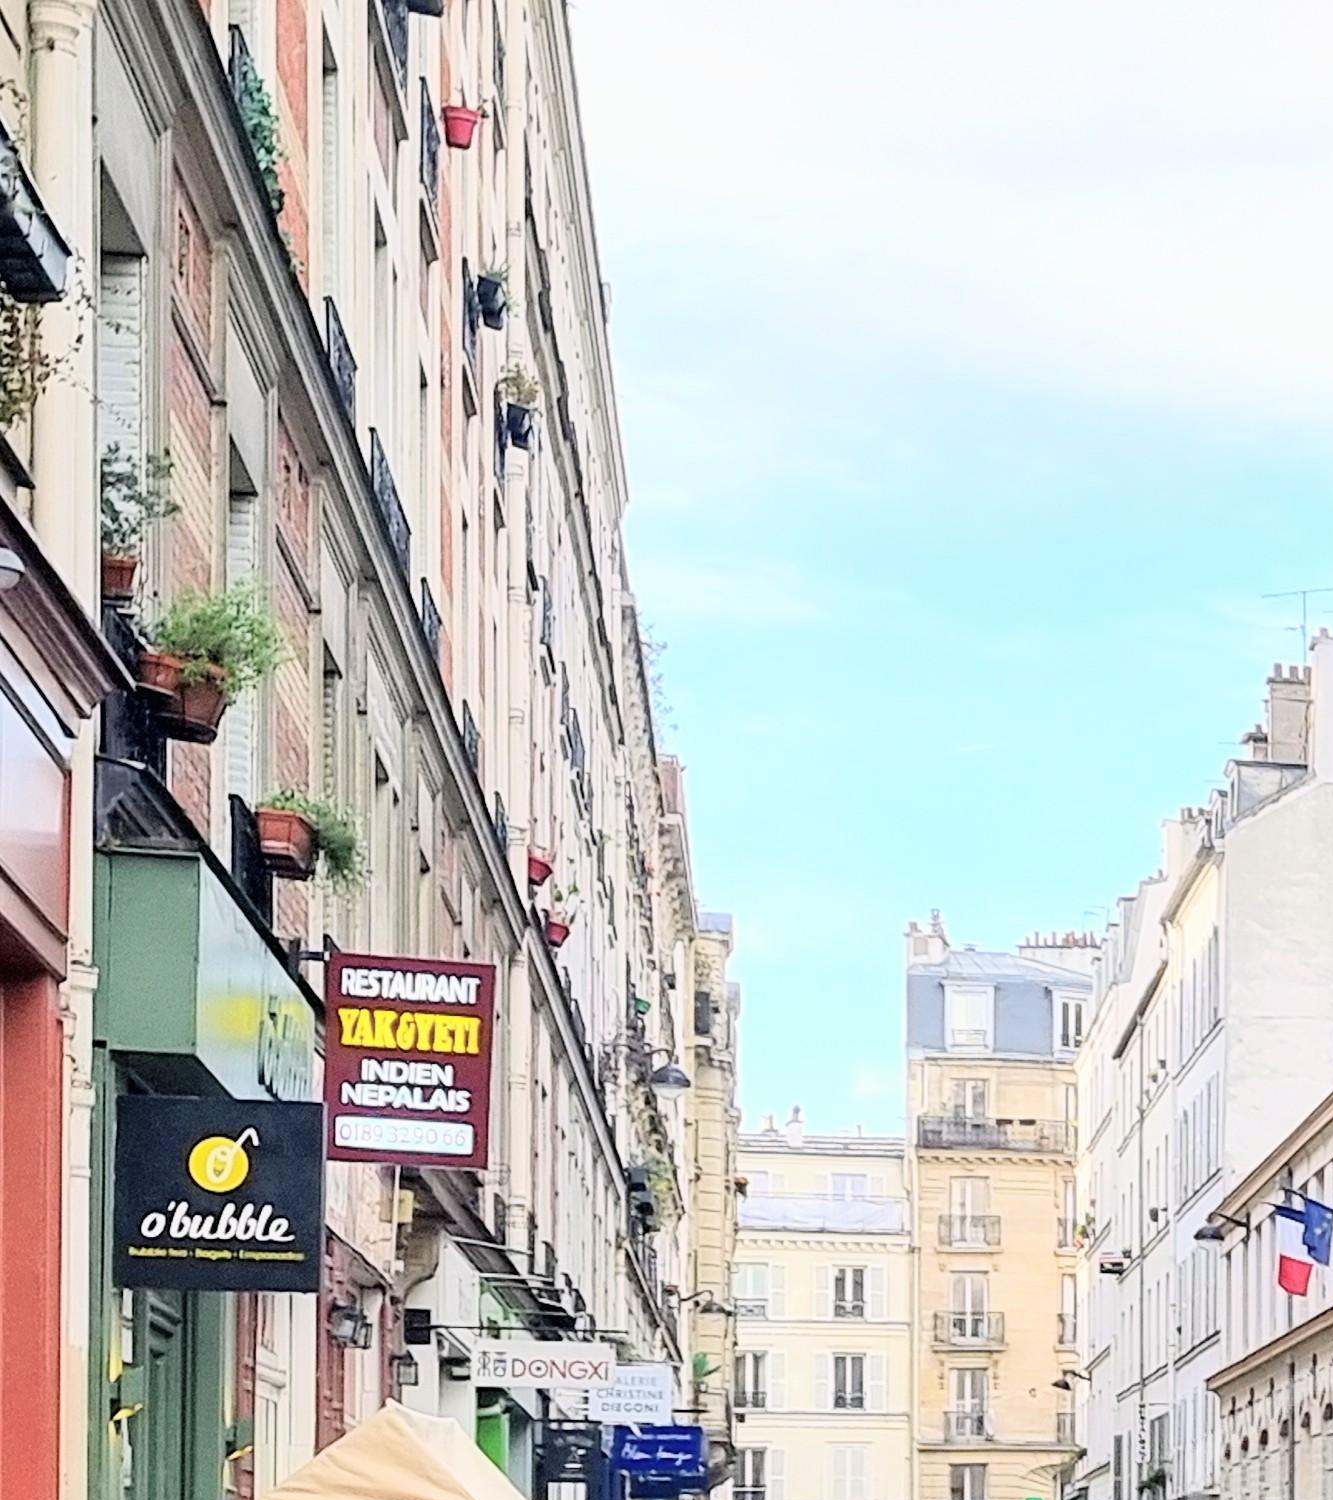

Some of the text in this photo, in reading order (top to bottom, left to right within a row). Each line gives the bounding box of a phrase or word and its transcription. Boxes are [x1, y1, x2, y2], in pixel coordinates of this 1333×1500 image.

[341, 967, 481, 1004] RESTAURANT
[361, 1058, 454, 1086] INDIEN
[341, 1082, 471, 1112] NEPALAIS
[141, 1201, 295, 1242] o'bubble
[613, 1375, 657, 1387] ALERIE
